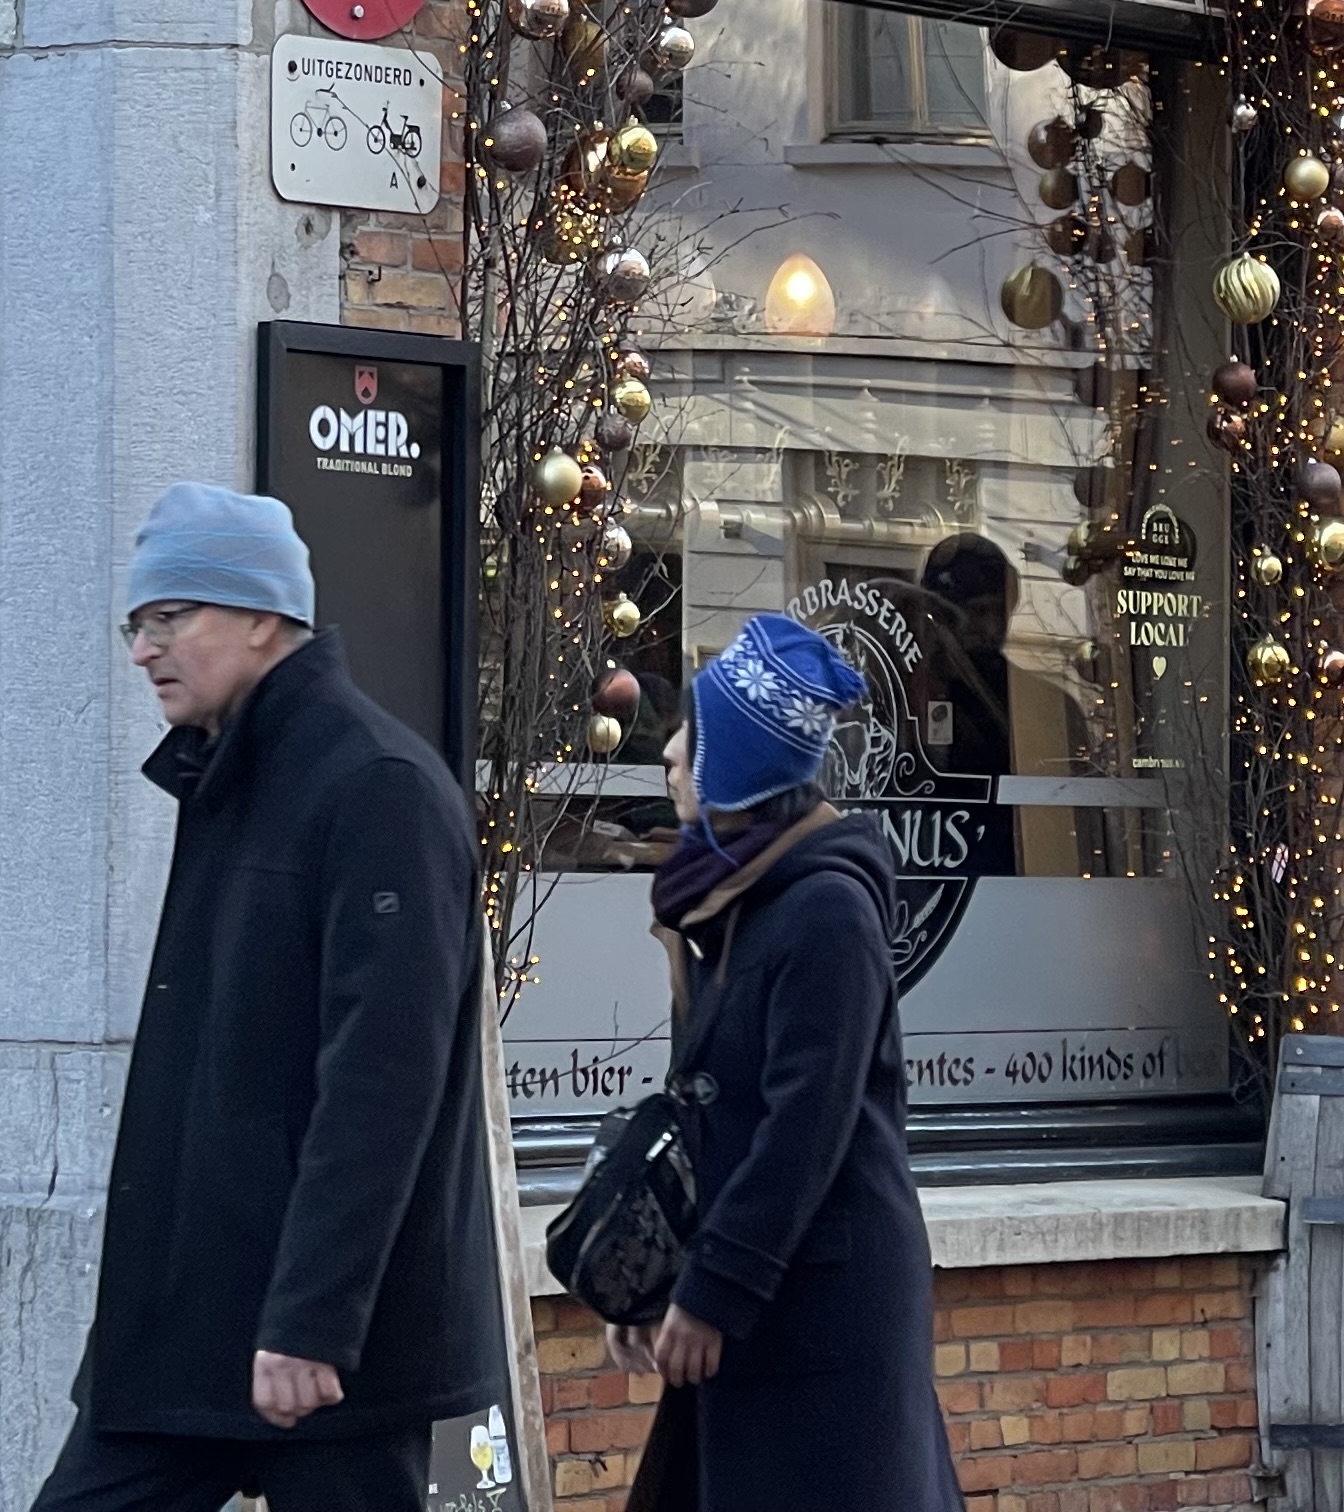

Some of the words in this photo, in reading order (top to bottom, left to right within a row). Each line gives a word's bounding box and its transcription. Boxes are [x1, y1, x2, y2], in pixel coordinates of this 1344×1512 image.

[300, 56, 414, 87] UITGEZONDERD
[388, 171, 399, 190] A
[316, 456, 380, 476] TRADITIONAL
[381, 462, 413, 478] BLOND
[1116, 588, 1202, 618] SUPPORT
[786, 577, 924, 674] RBRASSERIE
[1129, 620, 1189, 647] LOCAL
[571, 1048, 633, 1098] bier
[1005, 1050, 1053, 1085] 400
[1061, 1038, 1134, 1083] kinds
[1142, 1034, 1170, 1080] of
